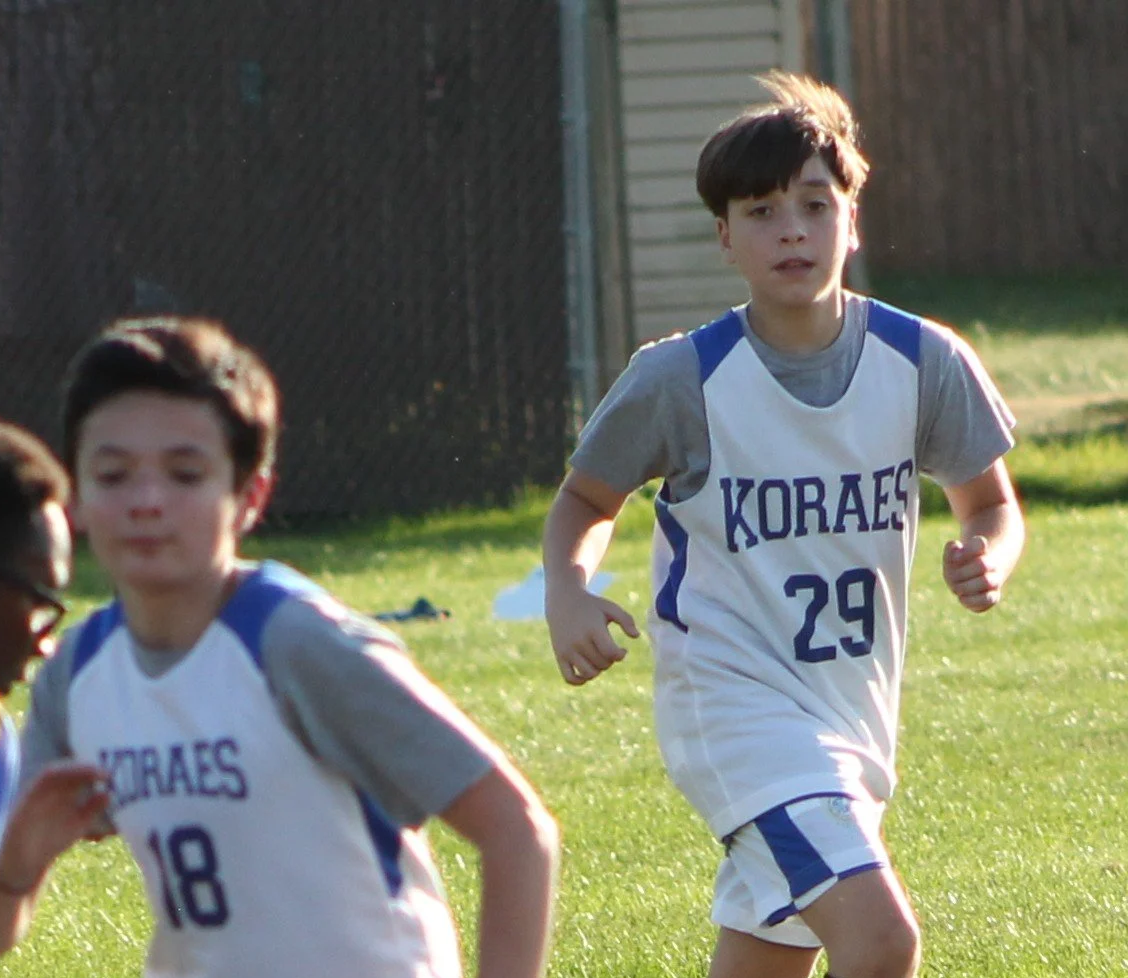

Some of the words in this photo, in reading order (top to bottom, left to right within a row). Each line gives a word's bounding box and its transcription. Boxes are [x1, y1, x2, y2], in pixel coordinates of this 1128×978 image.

[720, 459, 914, 553] KORAES
[783, 567, 876, 663] 29
[146, 825, 230, 930] 18
